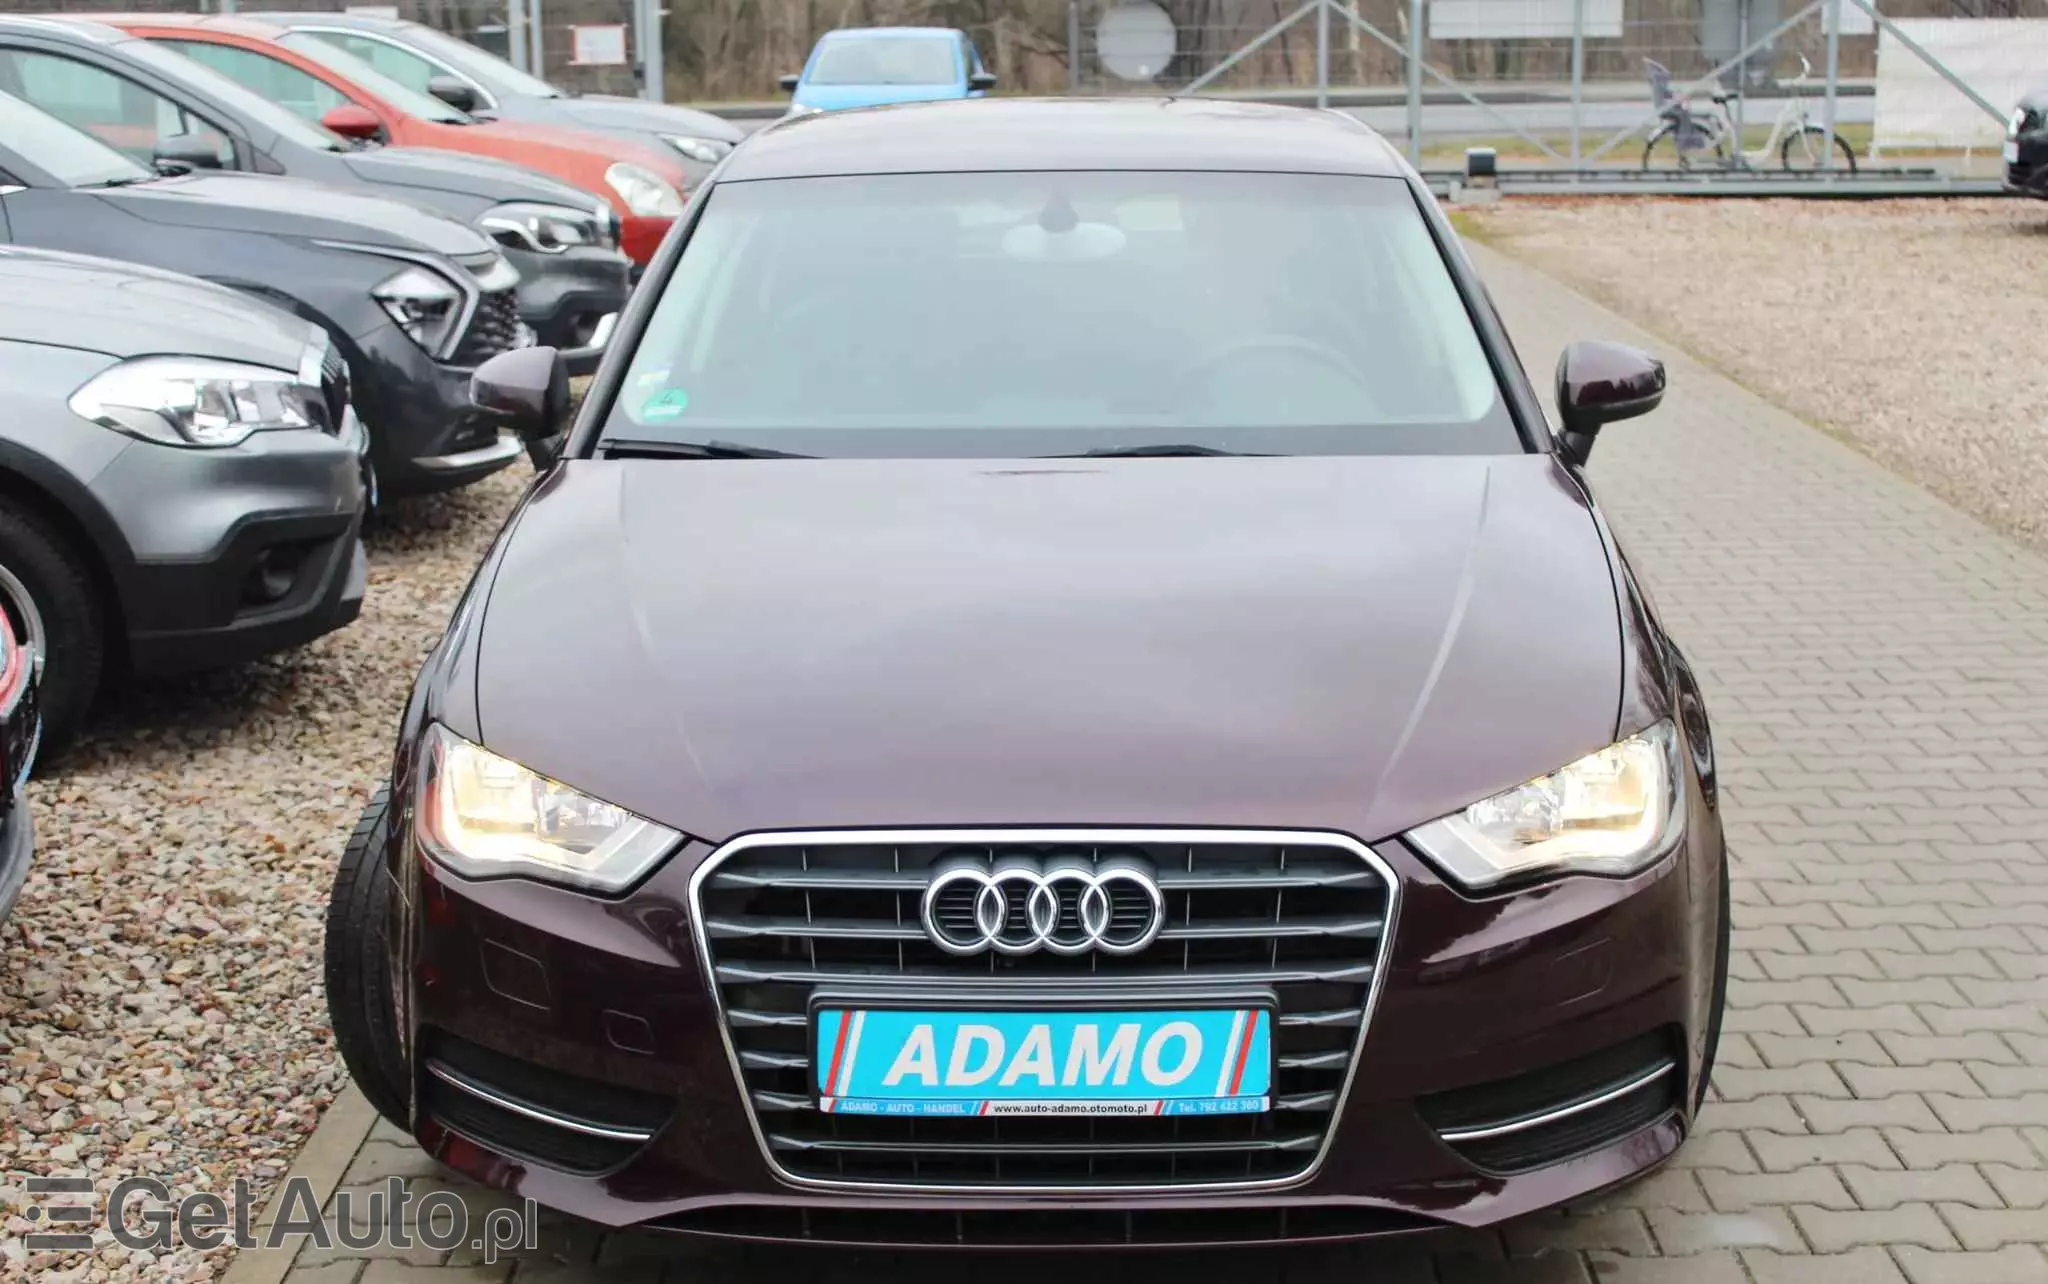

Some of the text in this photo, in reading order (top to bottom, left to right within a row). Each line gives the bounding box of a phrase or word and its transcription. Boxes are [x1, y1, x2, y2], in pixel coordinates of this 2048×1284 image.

[881, 1020, 1204, 1087] ADAMO
[841, 1101, 877, 1113] ADAMO
[886, 1103, 915, 1113] AUTO
[924, 1103, 965, 1114] HANDEL
[994, 1103, 1148, 1115] www.auto-adamo.otomoto.pl
